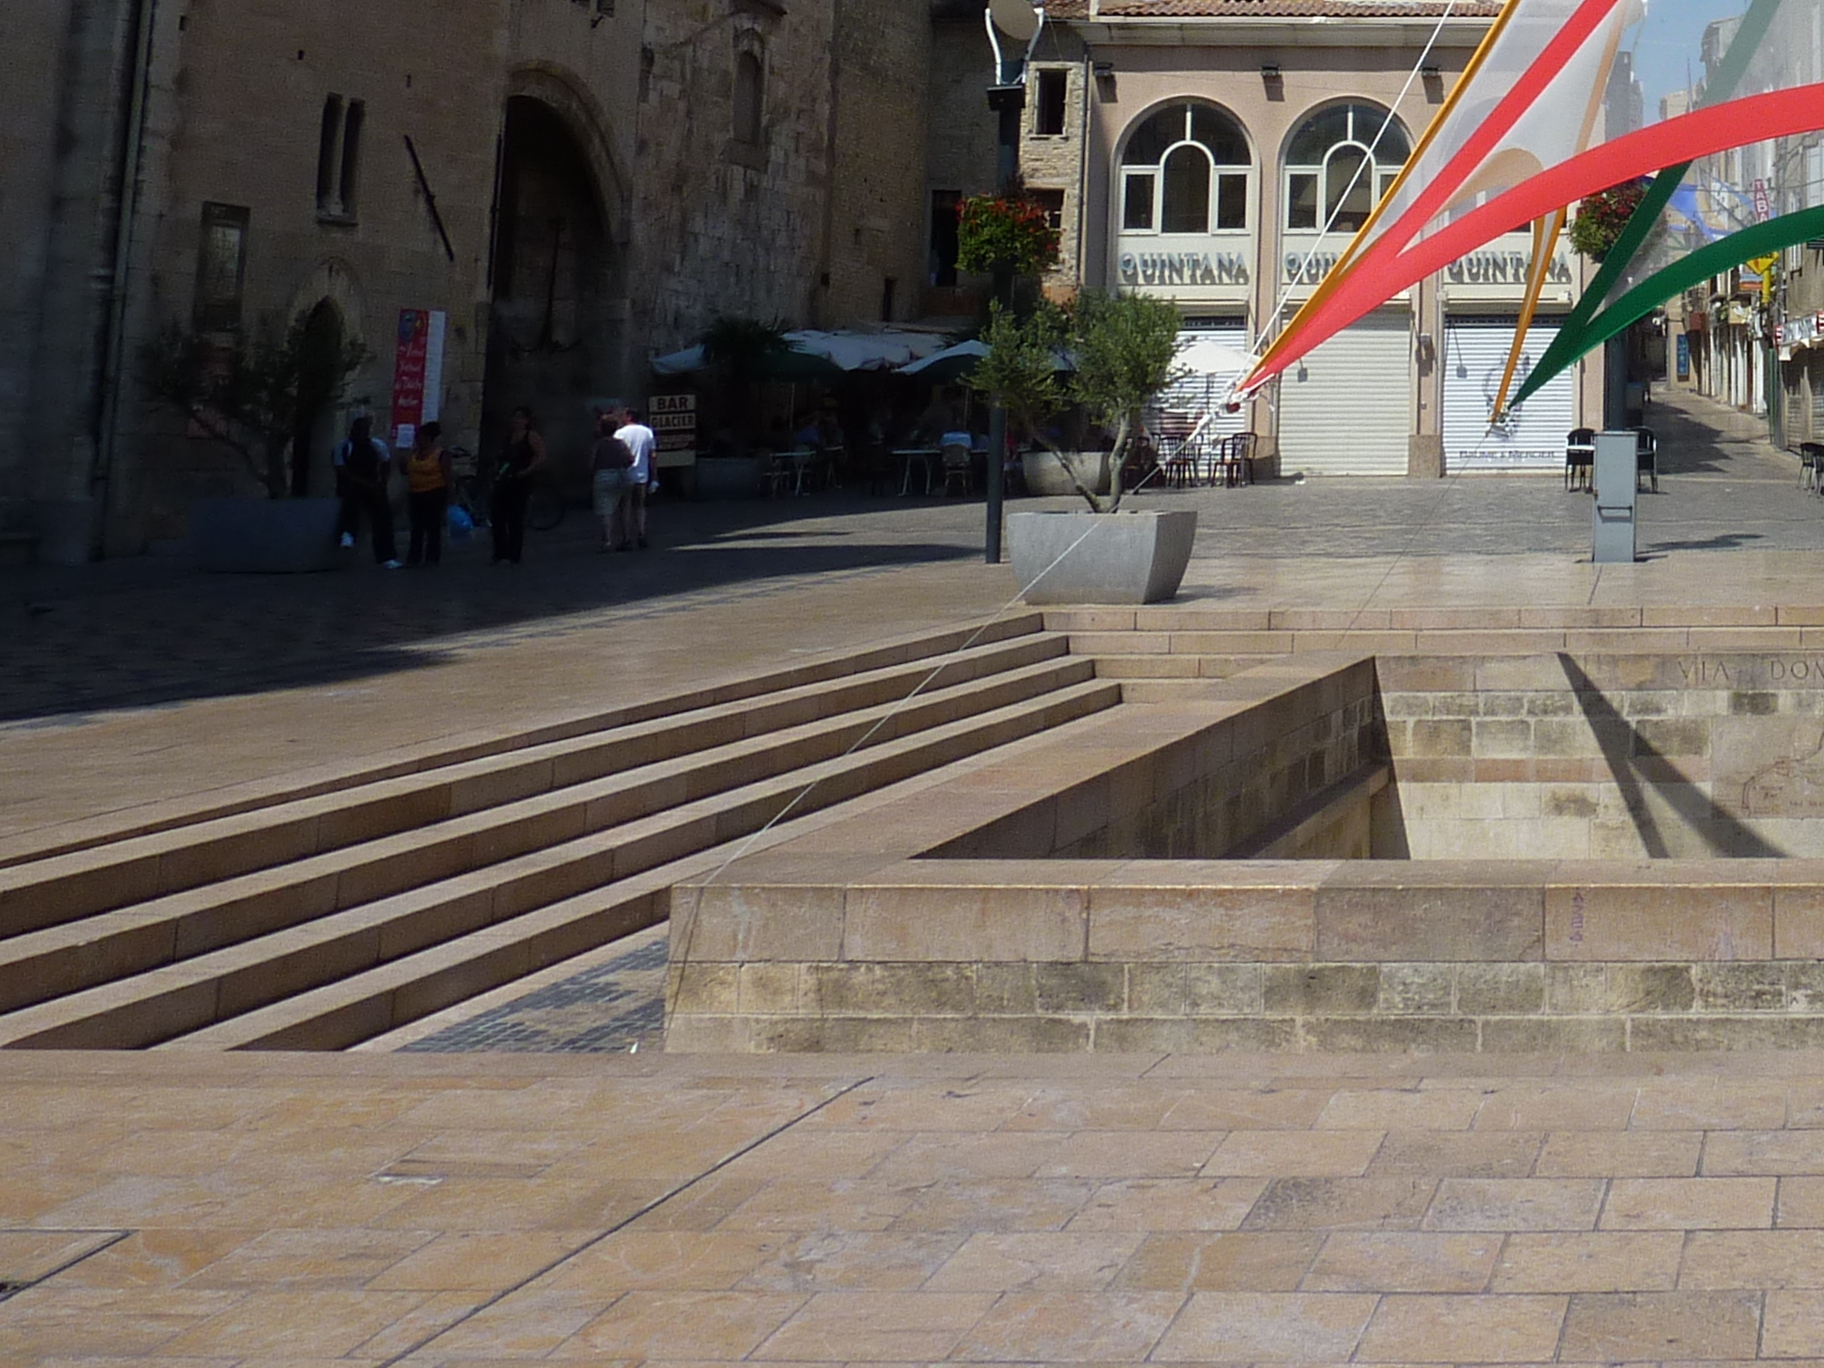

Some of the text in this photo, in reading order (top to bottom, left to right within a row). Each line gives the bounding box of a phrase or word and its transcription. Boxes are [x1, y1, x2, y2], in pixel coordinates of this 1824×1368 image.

[1118, 251, 1247, 277] QUINTANA
[657, 396, 688, 410] BAR
[650, 415, 694, 428] GLACIER
[1677, 659, 1730, 682] VIA
